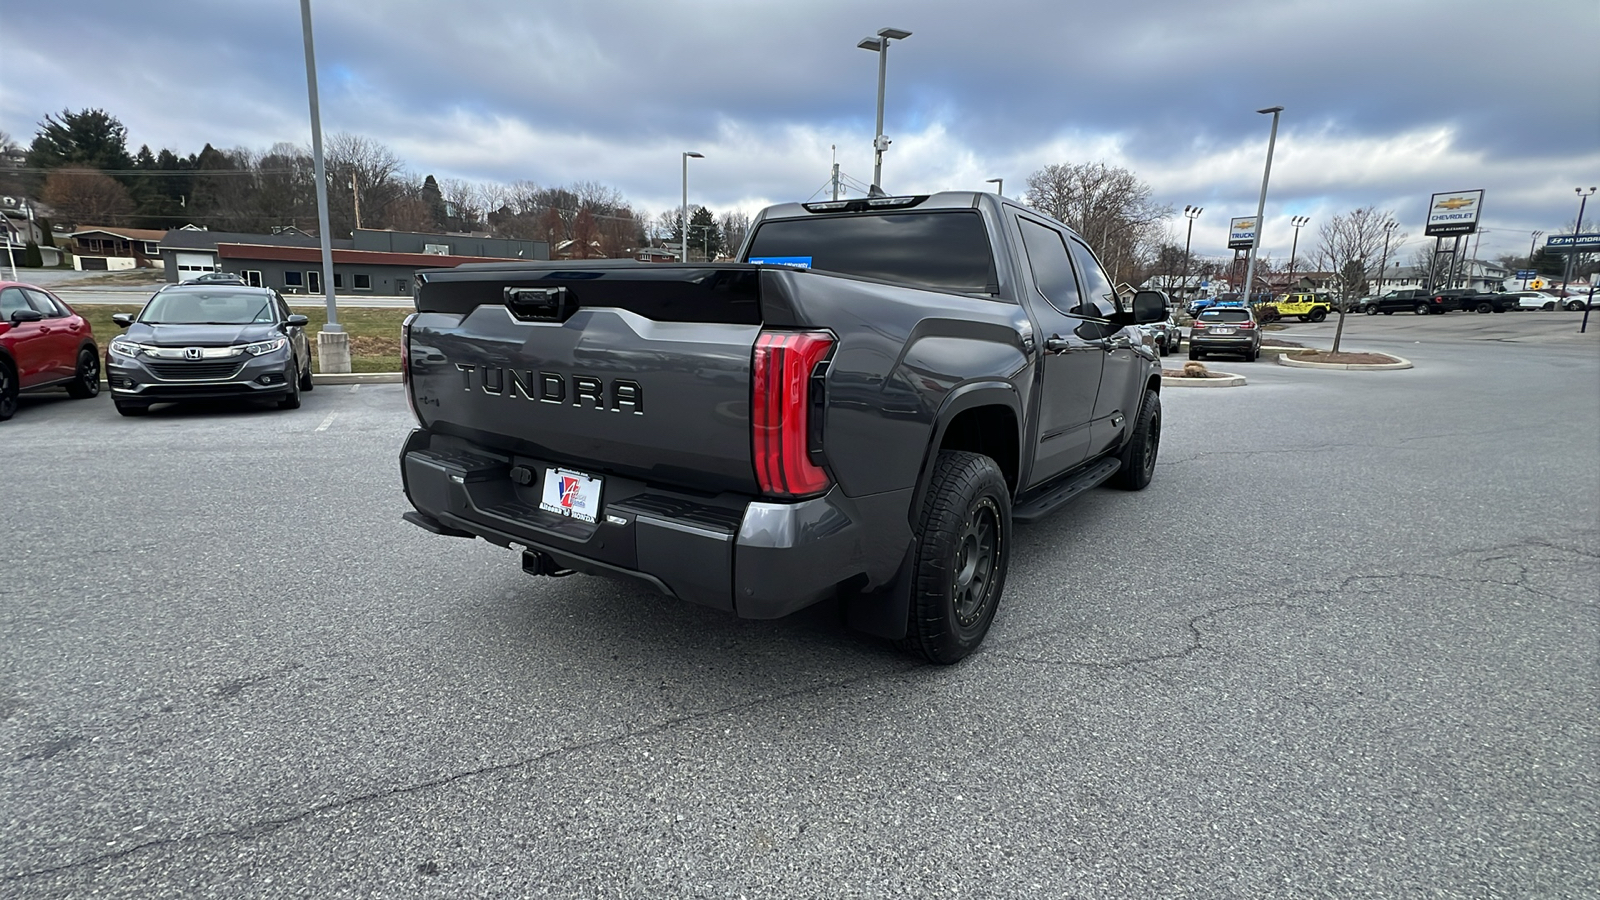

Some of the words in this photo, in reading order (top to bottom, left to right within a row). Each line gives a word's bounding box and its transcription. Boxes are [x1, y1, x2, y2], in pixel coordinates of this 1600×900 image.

[1431, 212, 1473, 221] CHEVROLET
[454, 362, 643, 415] TUNDRA
[571, 510, 596, 523] HONDA
